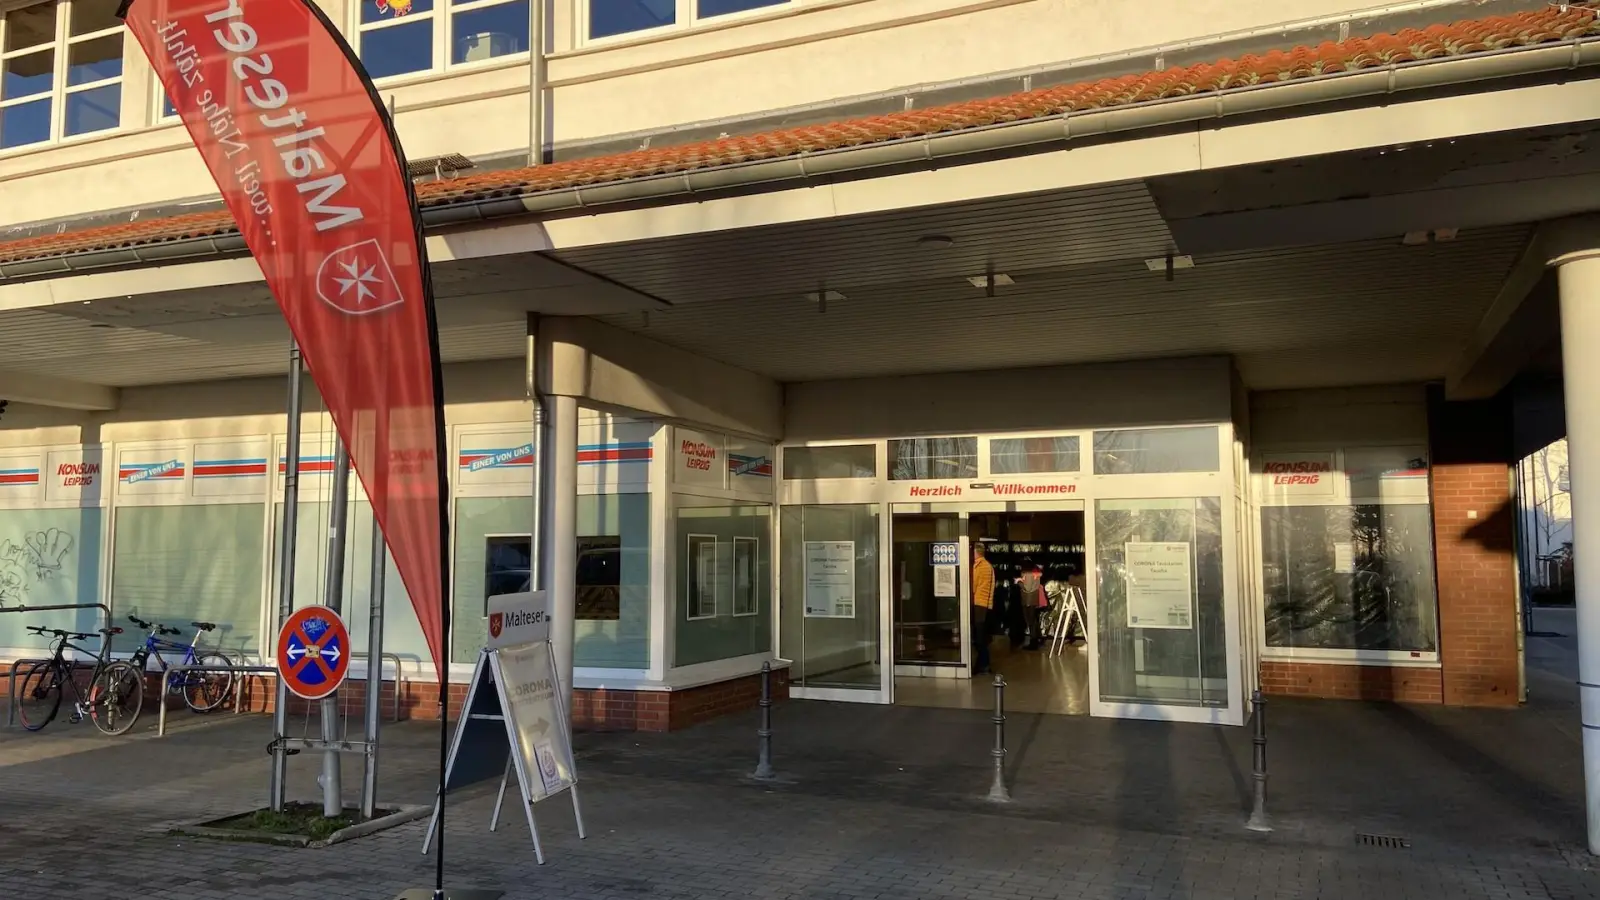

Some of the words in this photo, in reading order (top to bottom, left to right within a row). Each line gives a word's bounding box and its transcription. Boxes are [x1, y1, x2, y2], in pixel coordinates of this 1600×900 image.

[681, 440, 716, 459] KONSUM
[472, 455, 495, 470] EINER
[495, 451, 512, 463] VON
[514, 446, 530, 457] UNS
[686, 457, 711, 471] LEIPZIG
[57, 463, 100, 475] KONSUM
[1263, 461, 1332, 473] KONSUM
[63, 476, 92, 486] LEIPZIG
[1274, 474, 1320, 485] LEIPZIG
[909, 485, 962, 496] Herzlich
[992, 483, 1076, 495] Willkommen
[505, 610, 545, 628] Malteser
